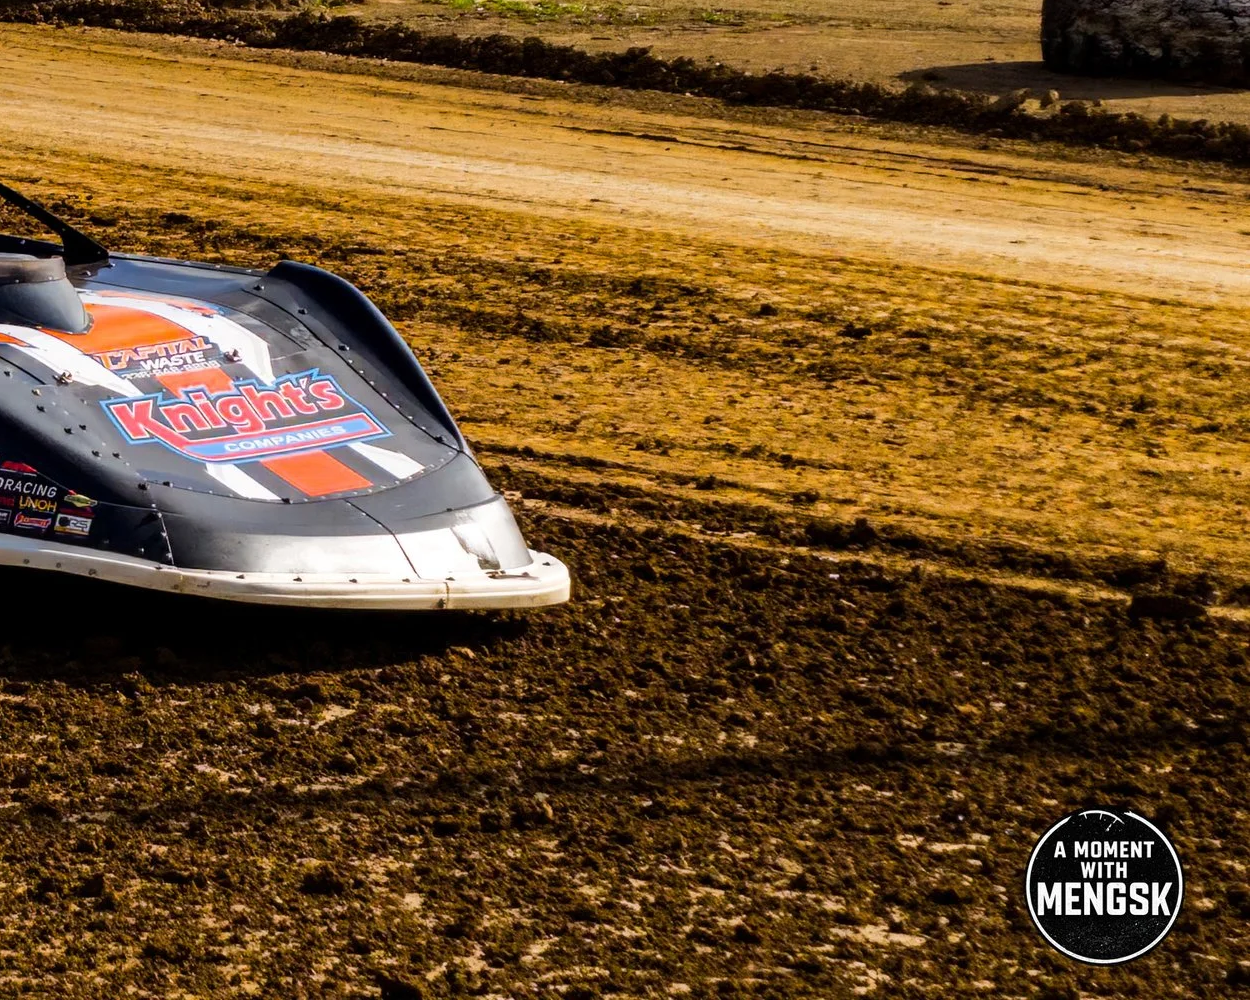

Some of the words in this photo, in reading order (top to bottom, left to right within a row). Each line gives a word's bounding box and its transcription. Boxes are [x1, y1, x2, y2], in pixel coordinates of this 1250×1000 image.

[93, 337, 213, 371] CAPITAL
[140, 350, 207, 371] WASTE
[109, 377, 346, 441] Knight's
[223, 424, 348, 452] COMPANIES
[19, 495, 58, 512] UNOH
